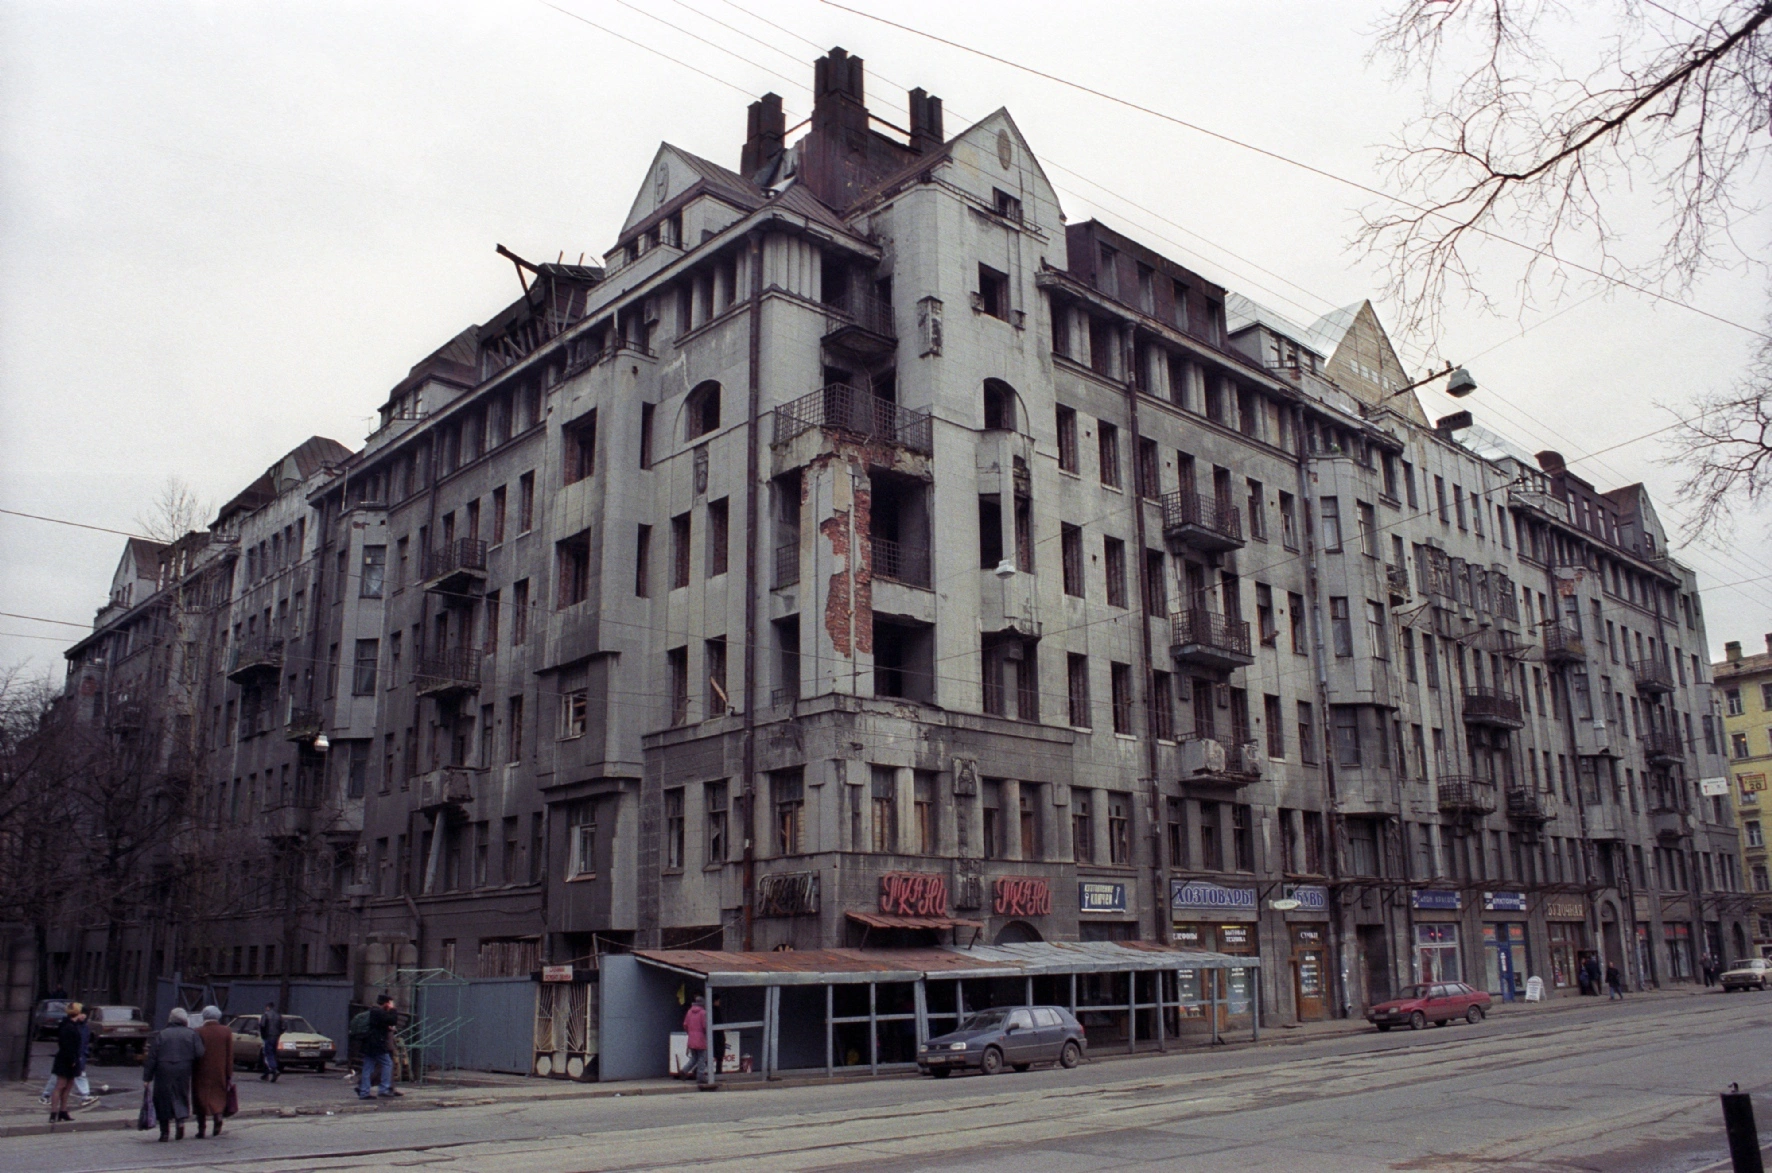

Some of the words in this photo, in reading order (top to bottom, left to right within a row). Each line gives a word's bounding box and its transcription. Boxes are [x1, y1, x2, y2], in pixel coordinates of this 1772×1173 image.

[1750, 782, 1761, 790] 20
[1175, 886, 1254, 905] ХОЗТОВАРЫ
[1293, 890, 1325, 907] БУВЬ
